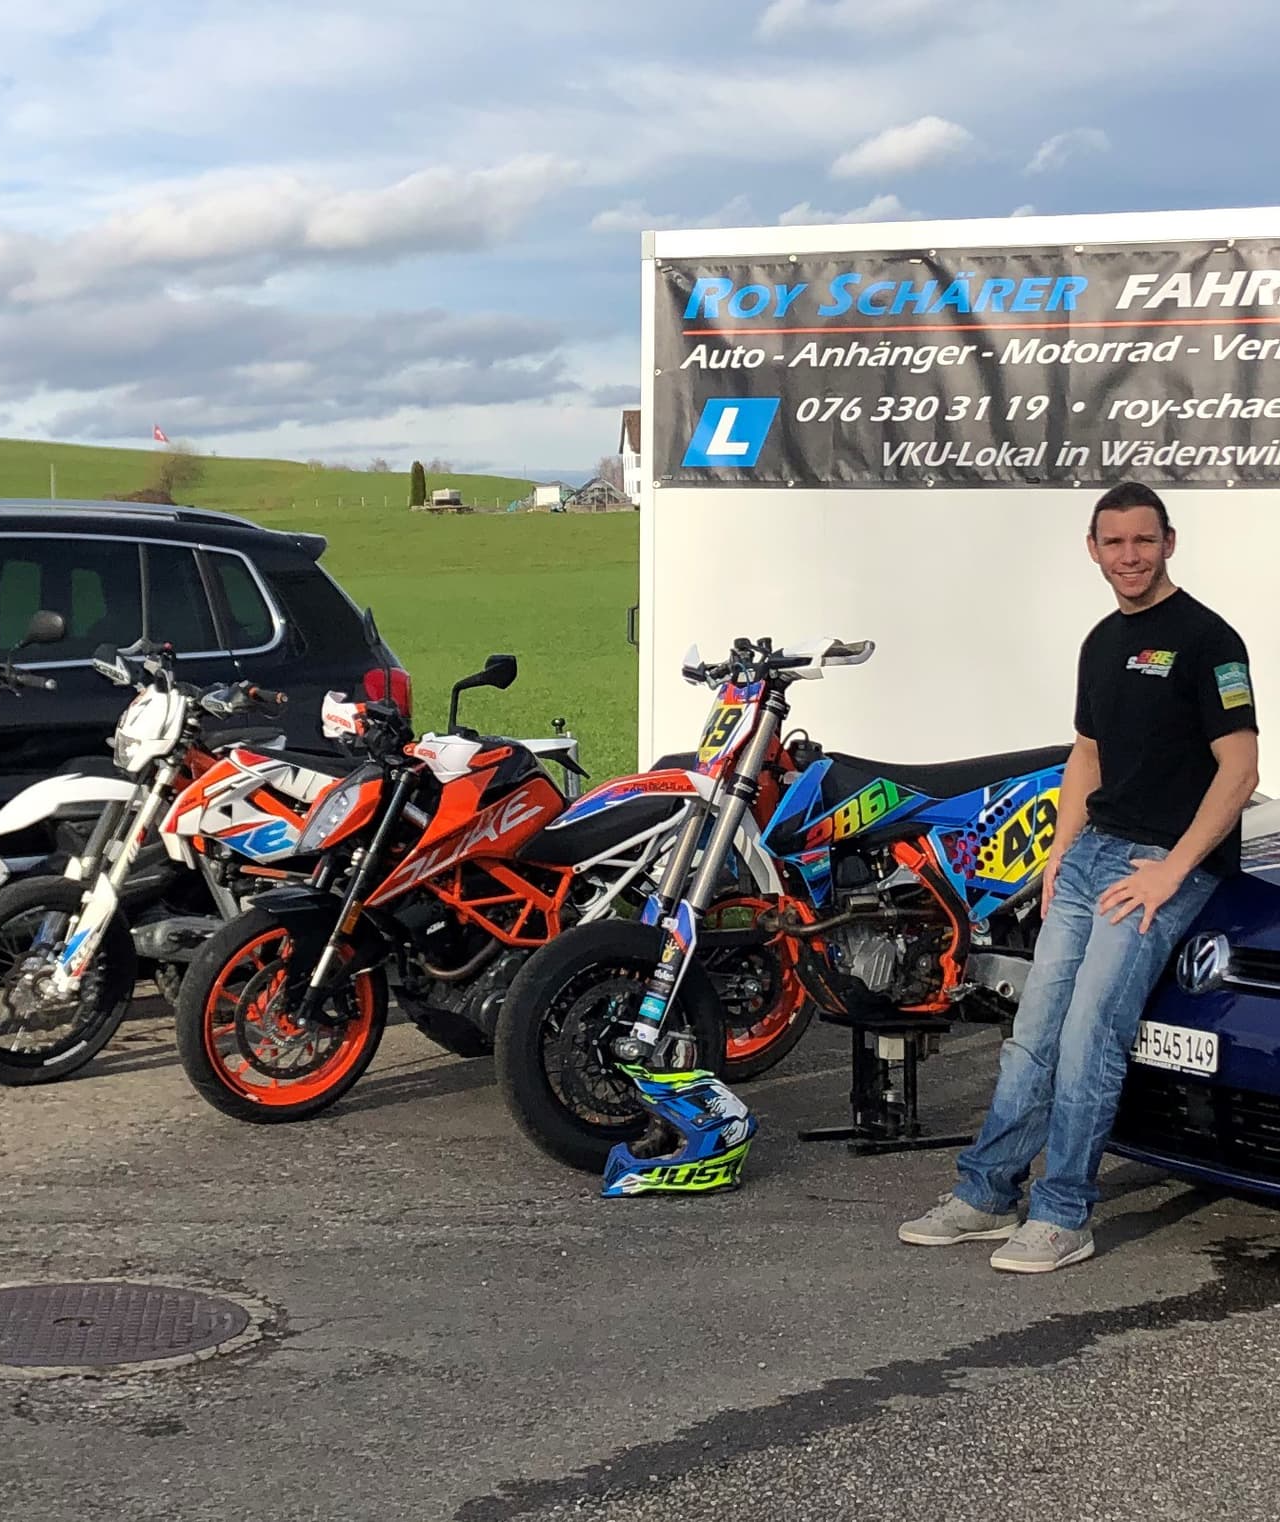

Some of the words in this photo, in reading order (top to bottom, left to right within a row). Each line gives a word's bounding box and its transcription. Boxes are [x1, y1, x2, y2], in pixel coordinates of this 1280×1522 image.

[680, 343, 766, 370] Auto
[788, 340, 977, 374] Anhänger
[998, 335, 1184, 366] Motorrad
[795, 396, 862, 422] 076
[870, 396, 939, 422] 330
[945, 396, 991, 421] 31
[1005, 395, 1051, 420] 19
[706, 407, 750, 456] L
[882, 440, 1048, 467] VKU-Lokal
[1055, 440, 1089, 467] in
[370, 790, 544, 906] DUKE
[1002, 798, 1058, 868] 49
